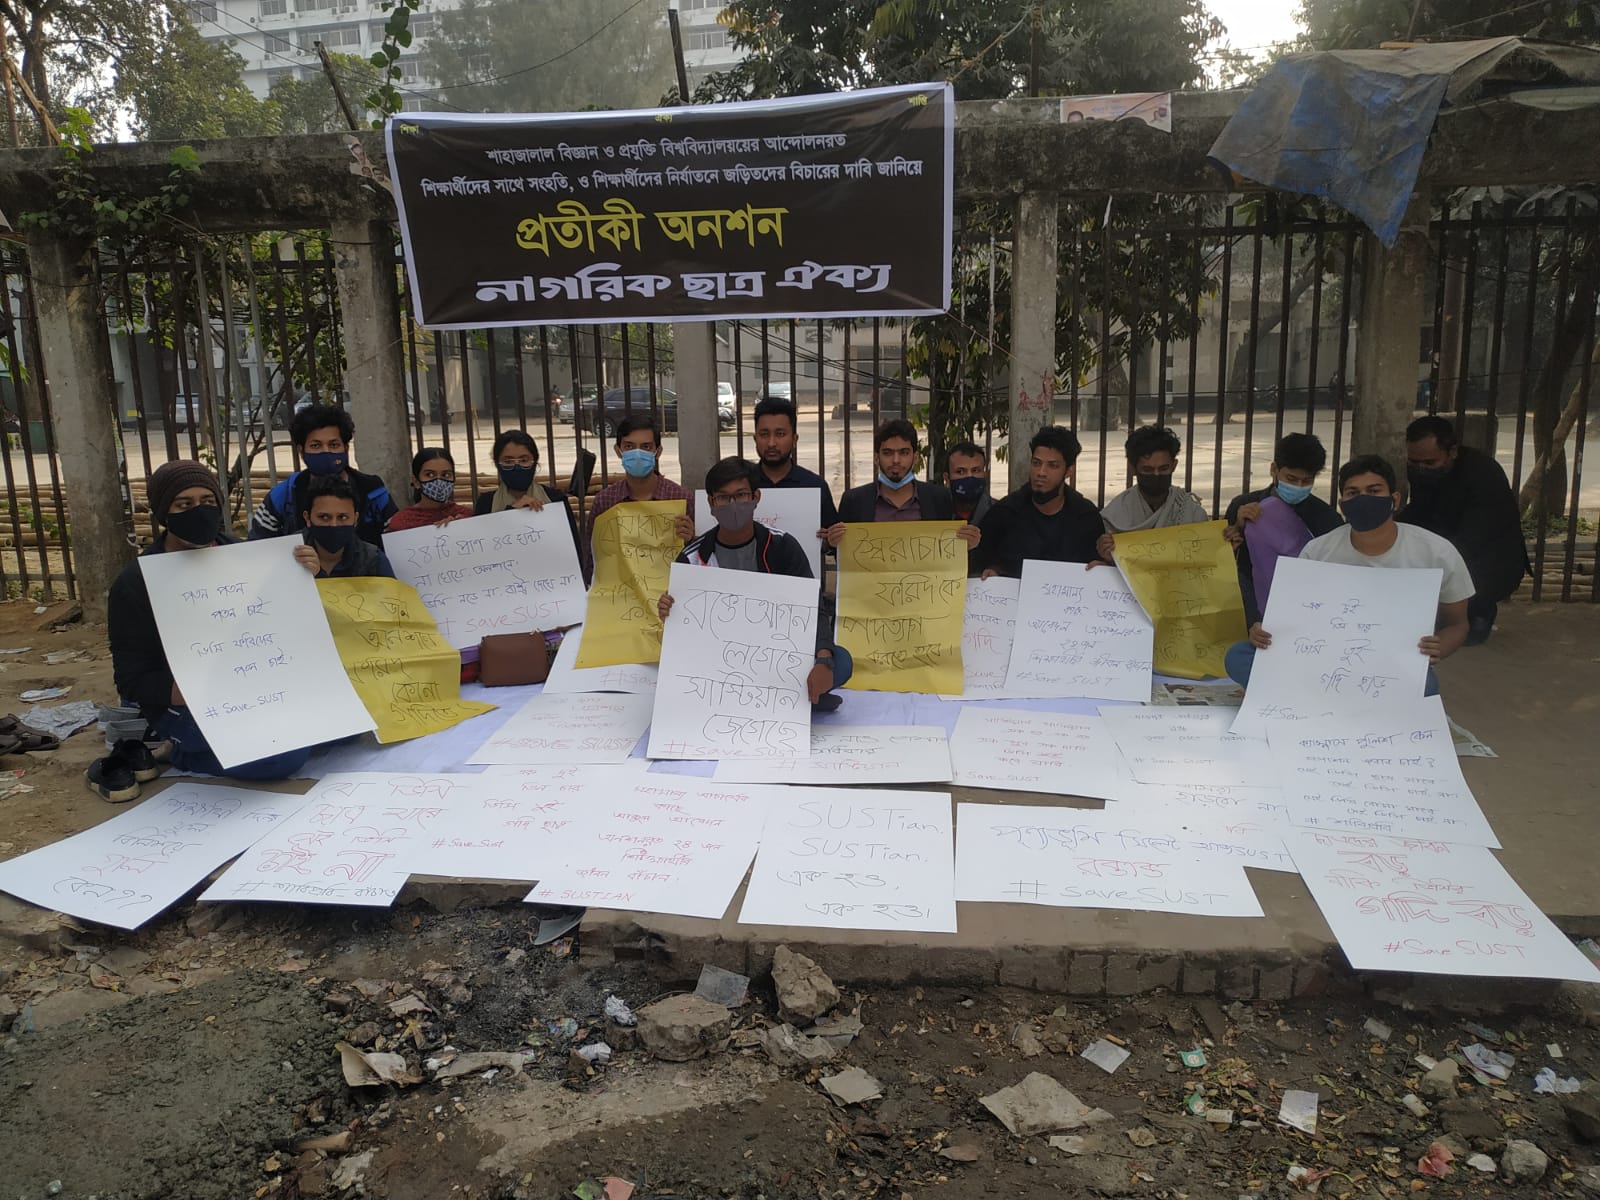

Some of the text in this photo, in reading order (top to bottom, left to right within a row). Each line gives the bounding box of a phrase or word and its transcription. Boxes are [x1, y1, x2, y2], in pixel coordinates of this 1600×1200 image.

[486, 147, 555, 166] শাহাজালাল
[556, 141, 599, 161] বিজ্ঞান
[601, 145, 616, 159] ও
[618, 138, 657, 163] প্রযুক্তি
[762, 132, 848, 152] আন্দোলনরত
[420, 155, 924, 198] শিক্ষার্থীদের সাথে সংহতি, ও শিক্ষার্থীদের নির্যাতনে জড়িতদের বিচারের দাবি জানিয়ে
[515, 197, 790, 258] প্রতীকী অনশন
[474, 260, 893, 302] নাগরিক ছাত্র ঐক্য
[722, 639, 816, 687] লেগেছে
[703, 712, 808, 752] জেগেছে
